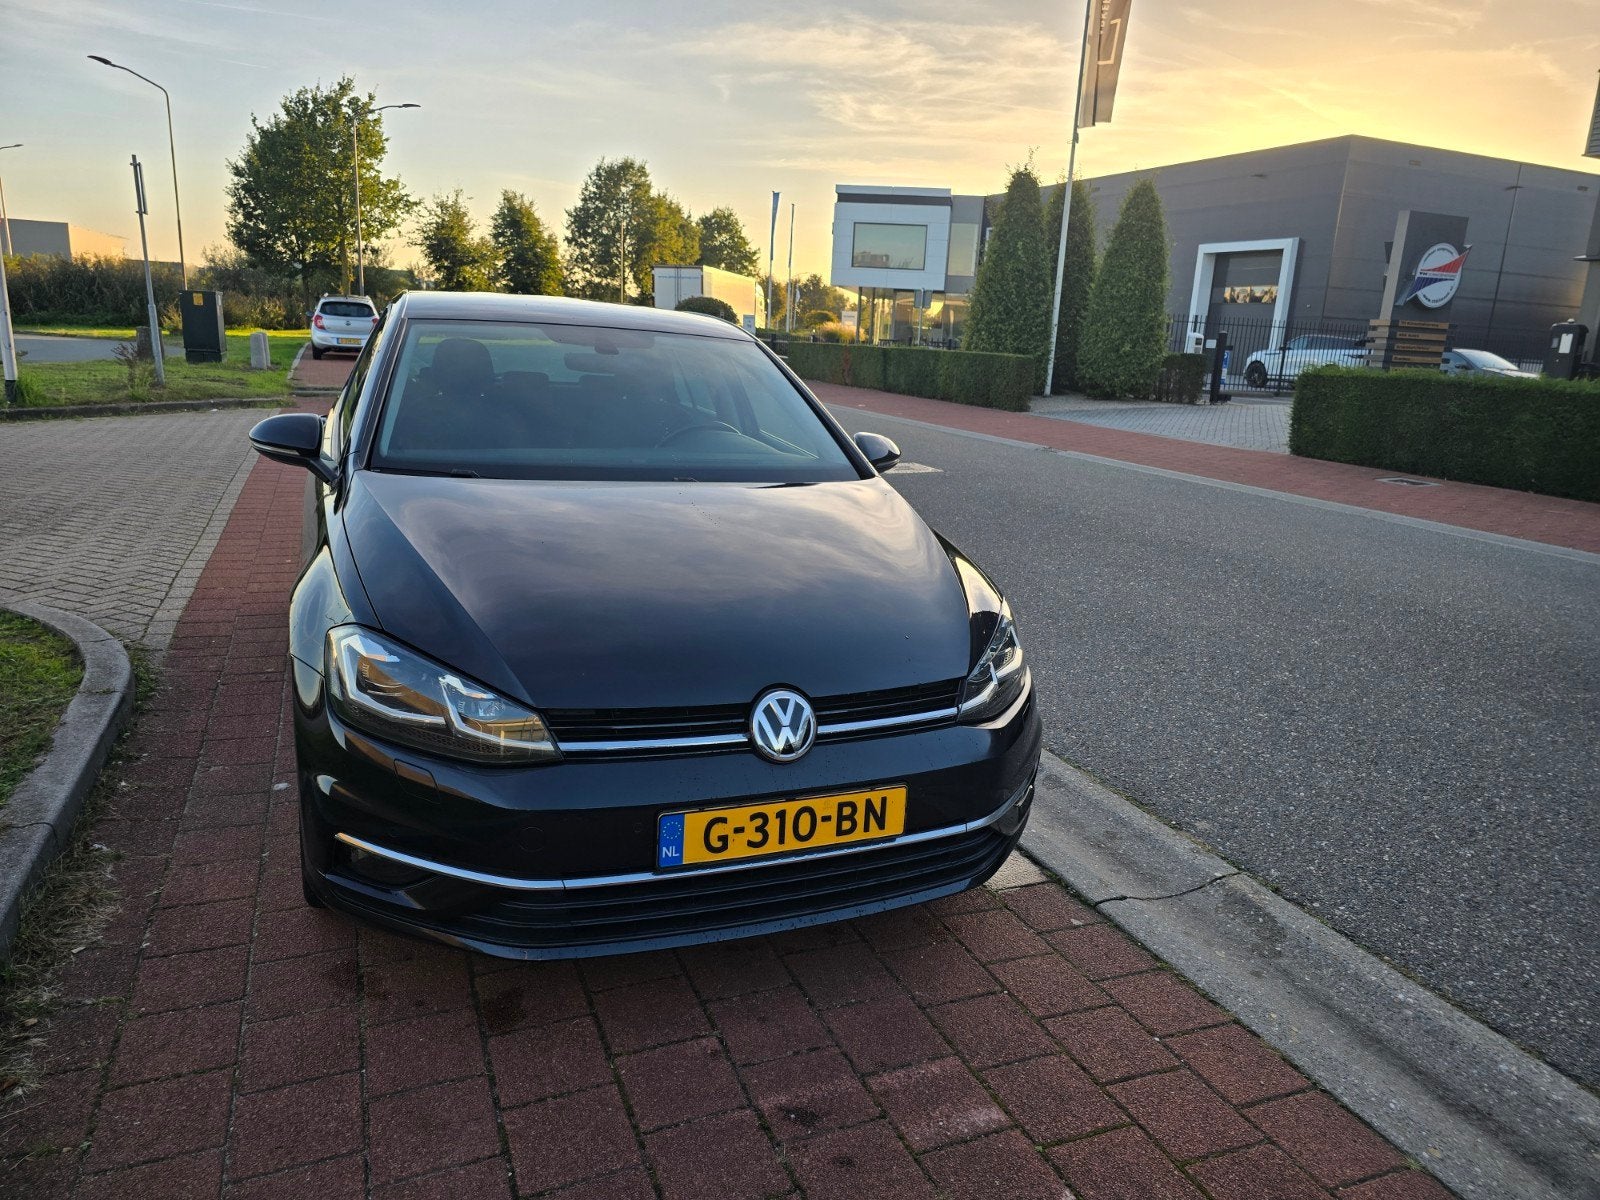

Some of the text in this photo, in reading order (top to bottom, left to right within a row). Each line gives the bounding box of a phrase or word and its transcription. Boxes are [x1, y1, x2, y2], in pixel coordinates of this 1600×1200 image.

[752, 689, 815, 759] VW
[662, 845, 680, 858] NL
[703, 796, 888, 854] G-310-BN
